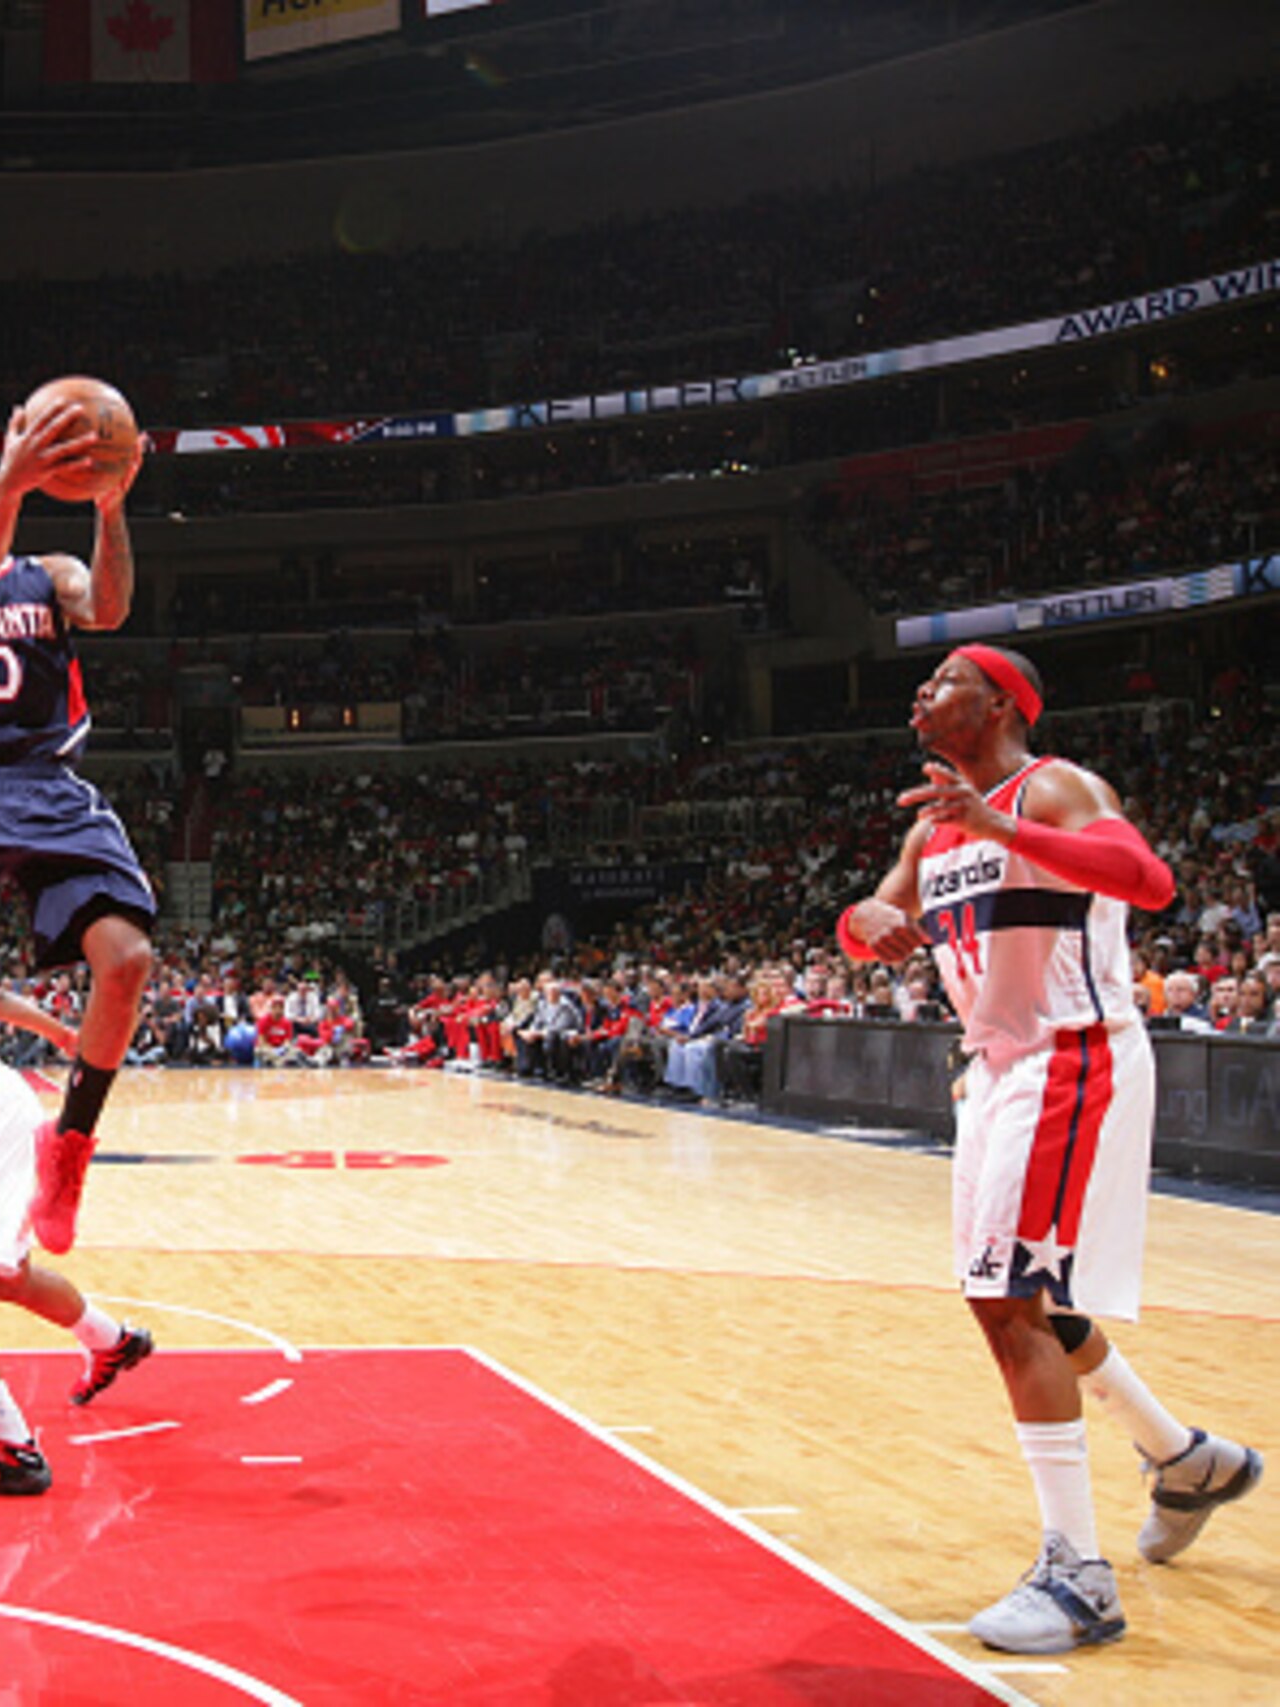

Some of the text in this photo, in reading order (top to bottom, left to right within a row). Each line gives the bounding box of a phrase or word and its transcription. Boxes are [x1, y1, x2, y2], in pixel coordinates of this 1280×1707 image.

[1055, 287, 1199, 343] AWARD
[1041, 586, 1158, 620] KETTLER
[922, 851, 1004, 898] izards
